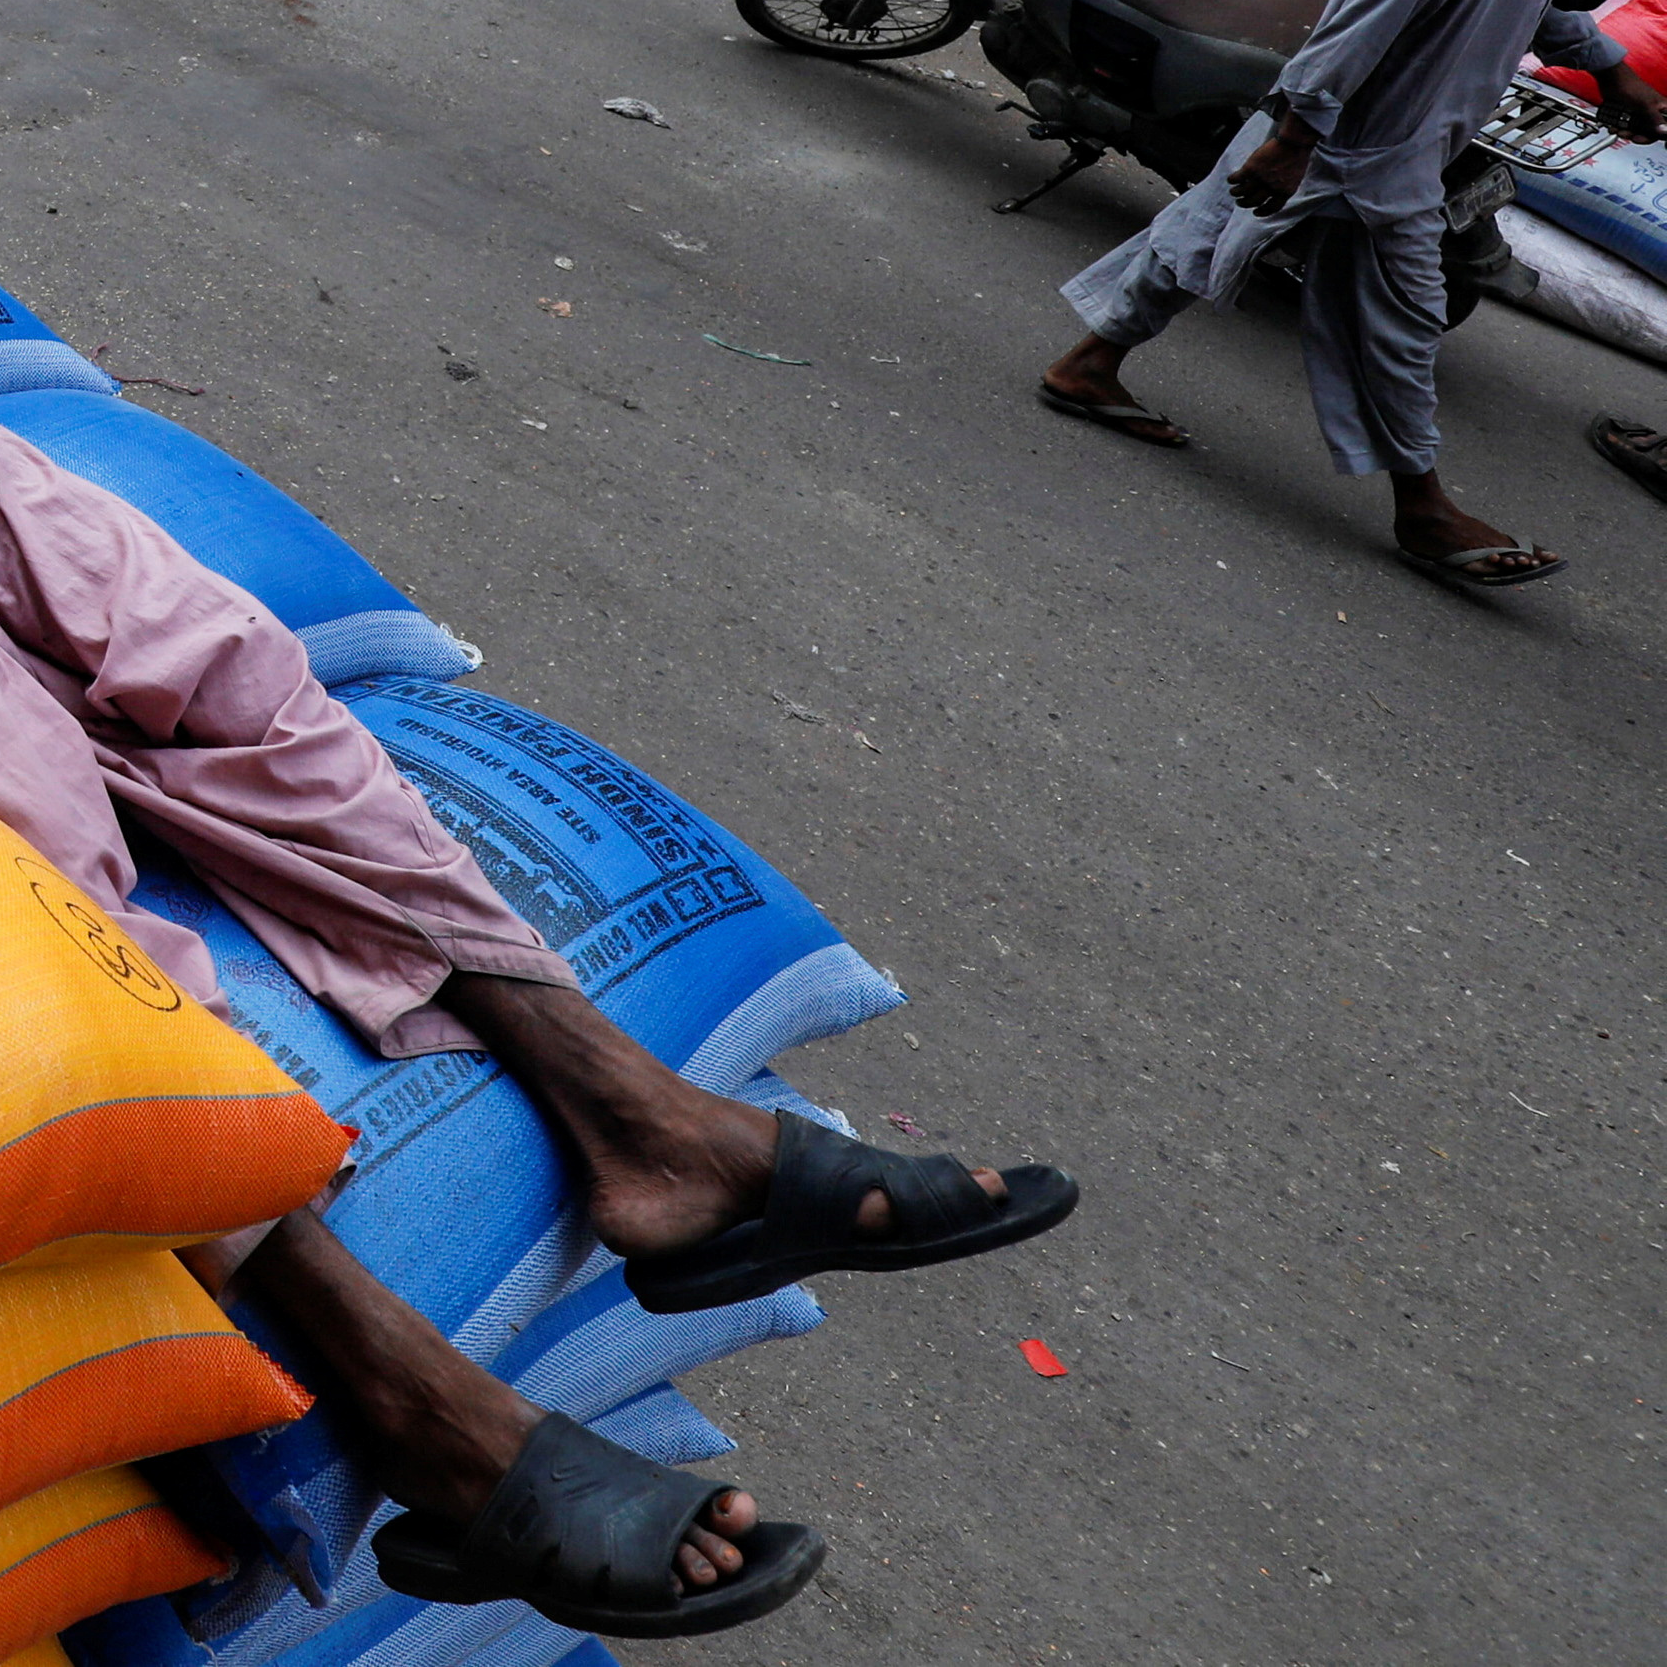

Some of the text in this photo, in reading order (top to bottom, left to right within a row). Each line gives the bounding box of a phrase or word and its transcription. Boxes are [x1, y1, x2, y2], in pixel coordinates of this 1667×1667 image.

[395, 683, 570, 760] PAKISTAN
[396, 717, 602, 845] SITE AREA HYDERABAD
[569, 762, 690, 862] SINDH
